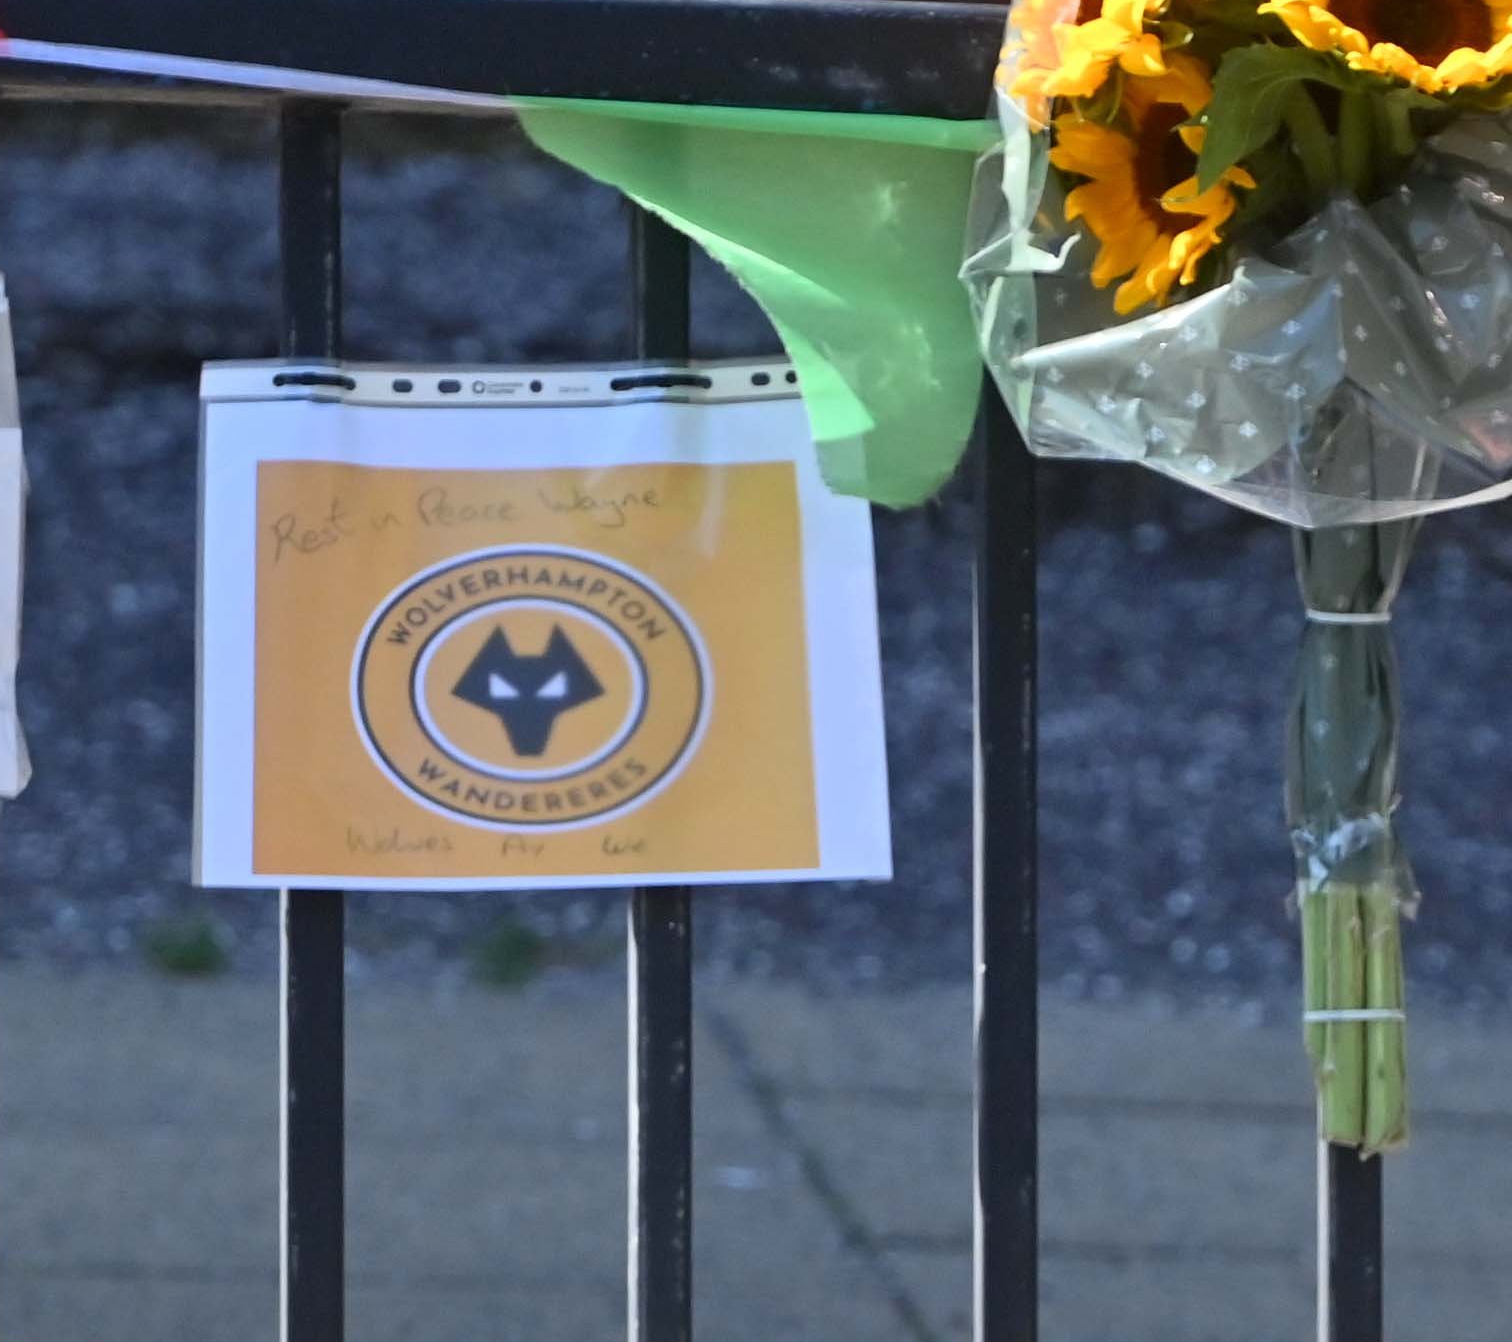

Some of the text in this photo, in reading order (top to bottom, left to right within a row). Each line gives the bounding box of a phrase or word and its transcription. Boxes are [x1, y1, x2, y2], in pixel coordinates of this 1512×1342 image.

[272, 499, 351, 564] Rest
[418, 485, 520, 527] Peace
[537, 486, 660, 528] Wayne
[386, 564, 667, 647] WOLVERHAMPTON
[418, 756, 648, 812] WANDERERES
[346, 825, 454, 854] Wolves
